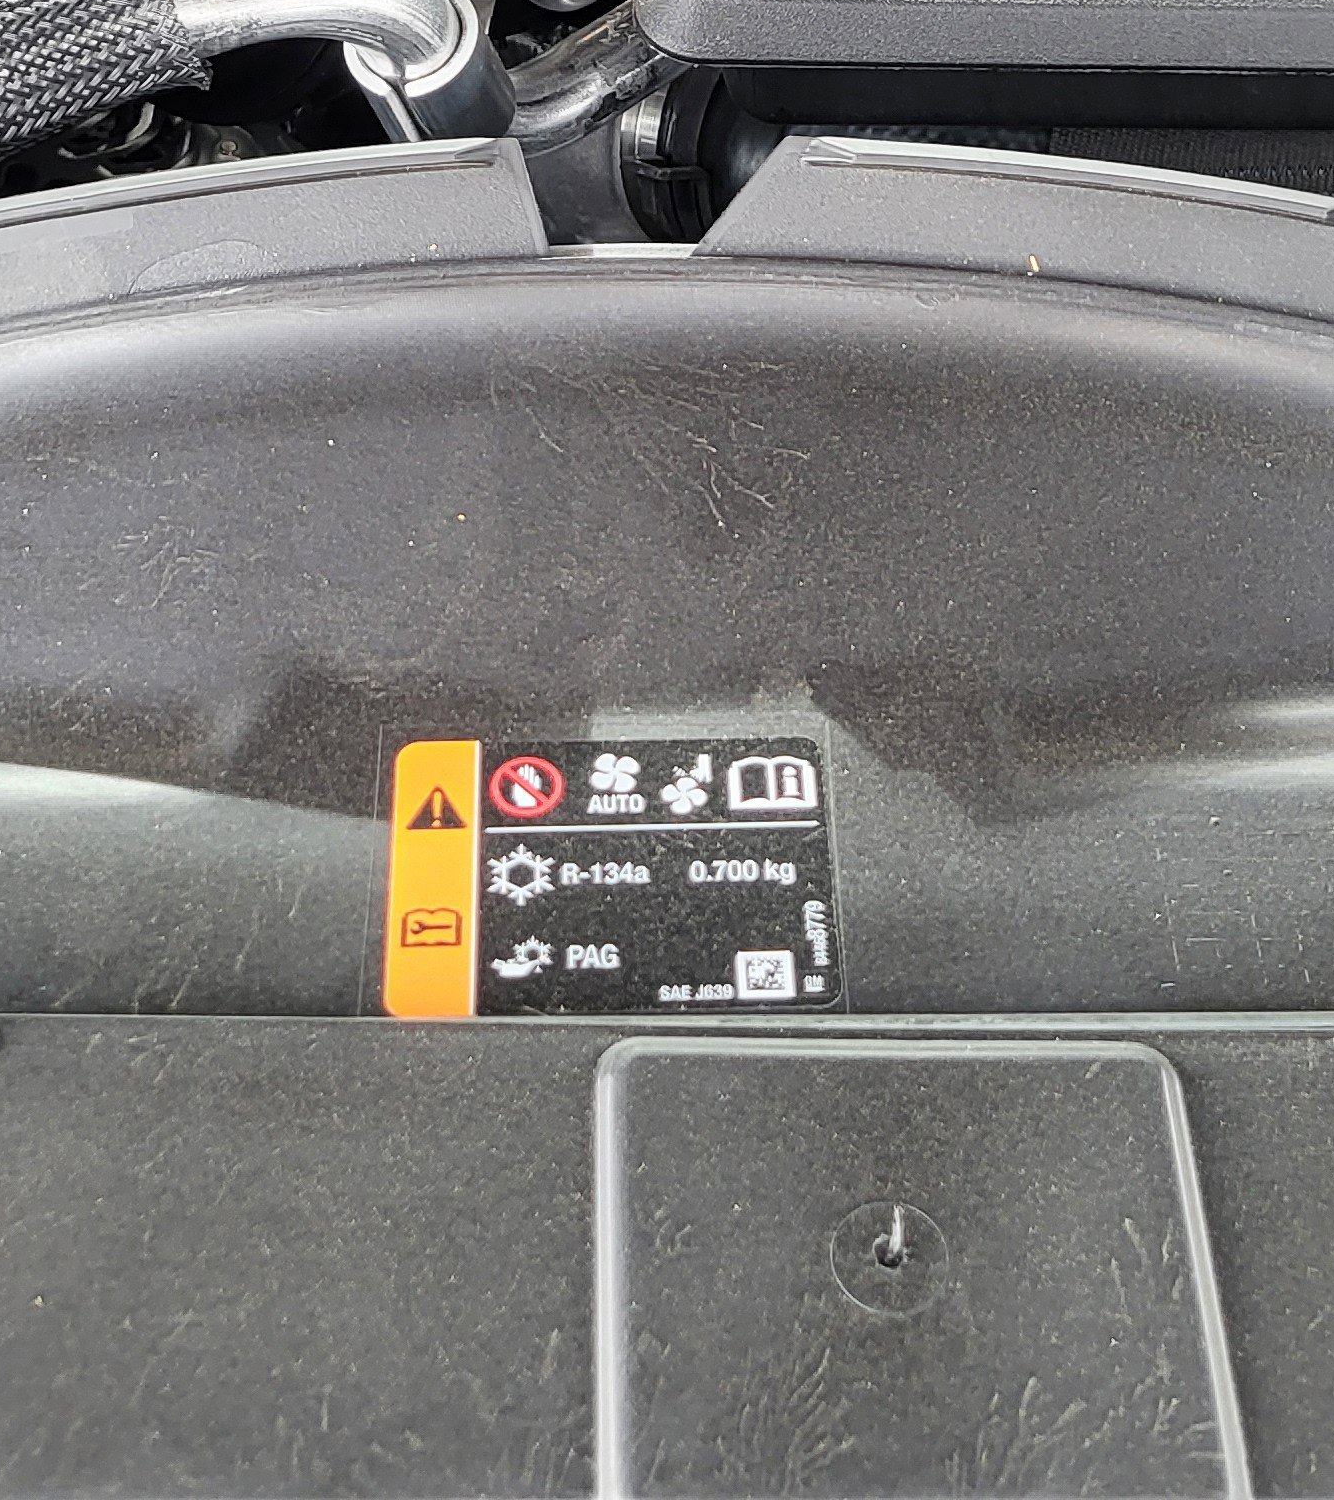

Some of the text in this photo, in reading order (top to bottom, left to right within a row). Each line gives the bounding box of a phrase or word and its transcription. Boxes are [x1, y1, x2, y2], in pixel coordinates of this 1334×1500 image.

[587, 794, 647, 814] AUTO
[560, 858, 798, 885] R-134a 0.700 kg
[566, 943, 621, 970] PAG
[658, 984, 693, 1001] SAE
